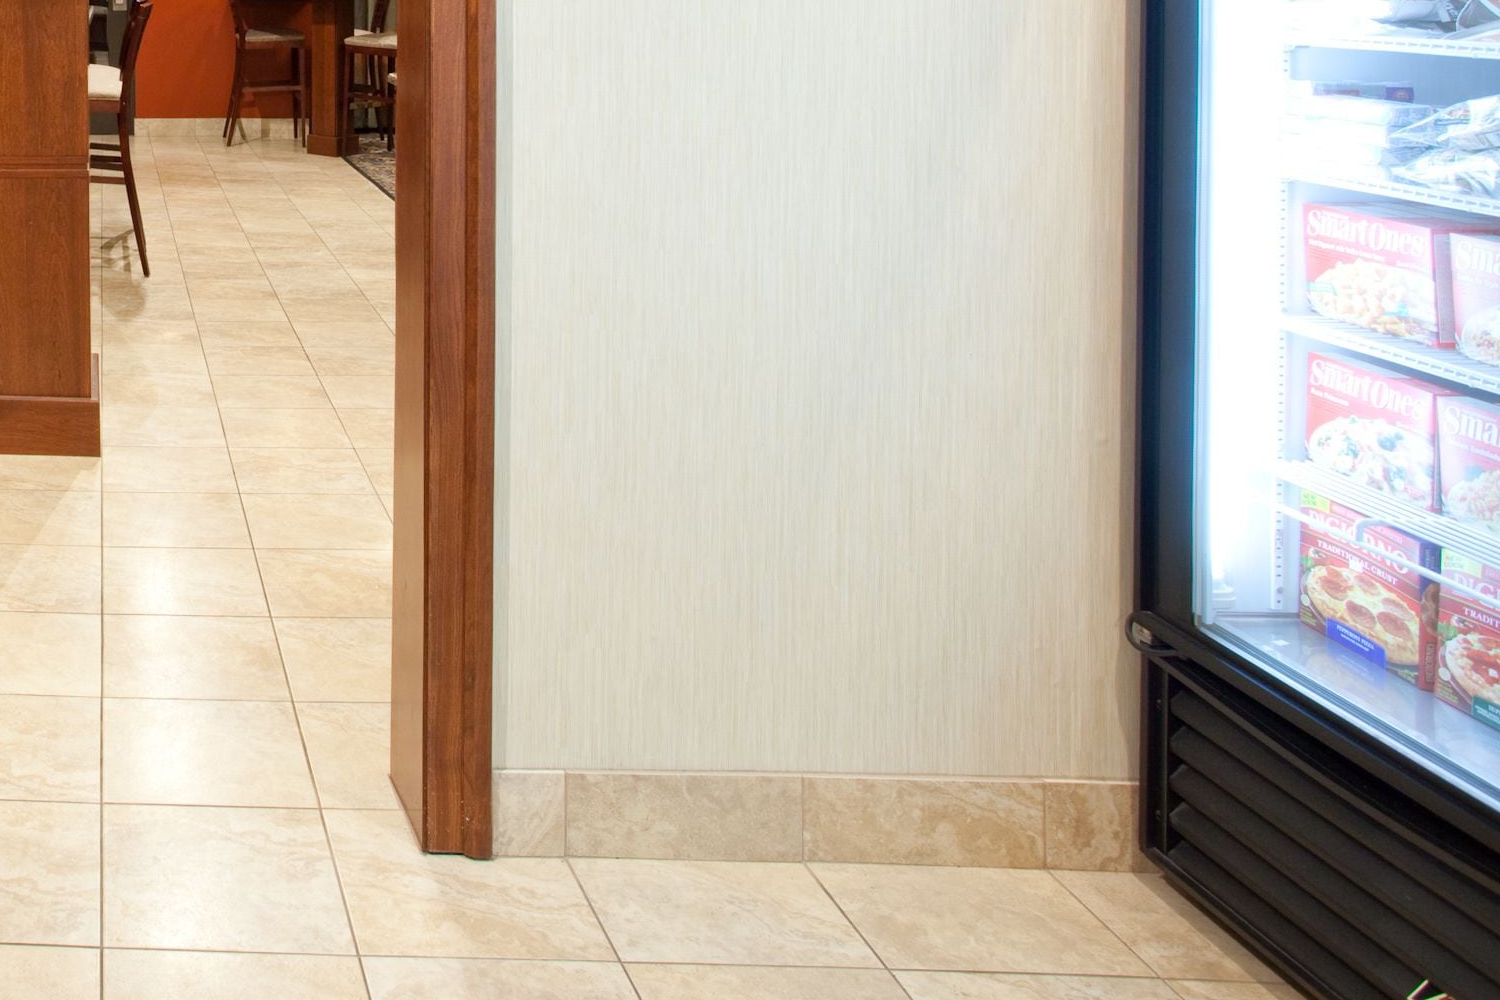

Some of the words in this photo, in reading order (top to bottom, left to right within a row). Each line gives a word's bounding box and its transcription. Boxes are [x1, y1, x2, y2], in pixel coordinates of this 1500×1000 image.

[1307, 209, 1369, 246] Smart
[1369, 222, 1425, 258] Ones
[1310, 359, 1372, 398] Smart
[1370, 380, 1423, 420] Ones
[1372, 565, 1399, 585] CRUST
